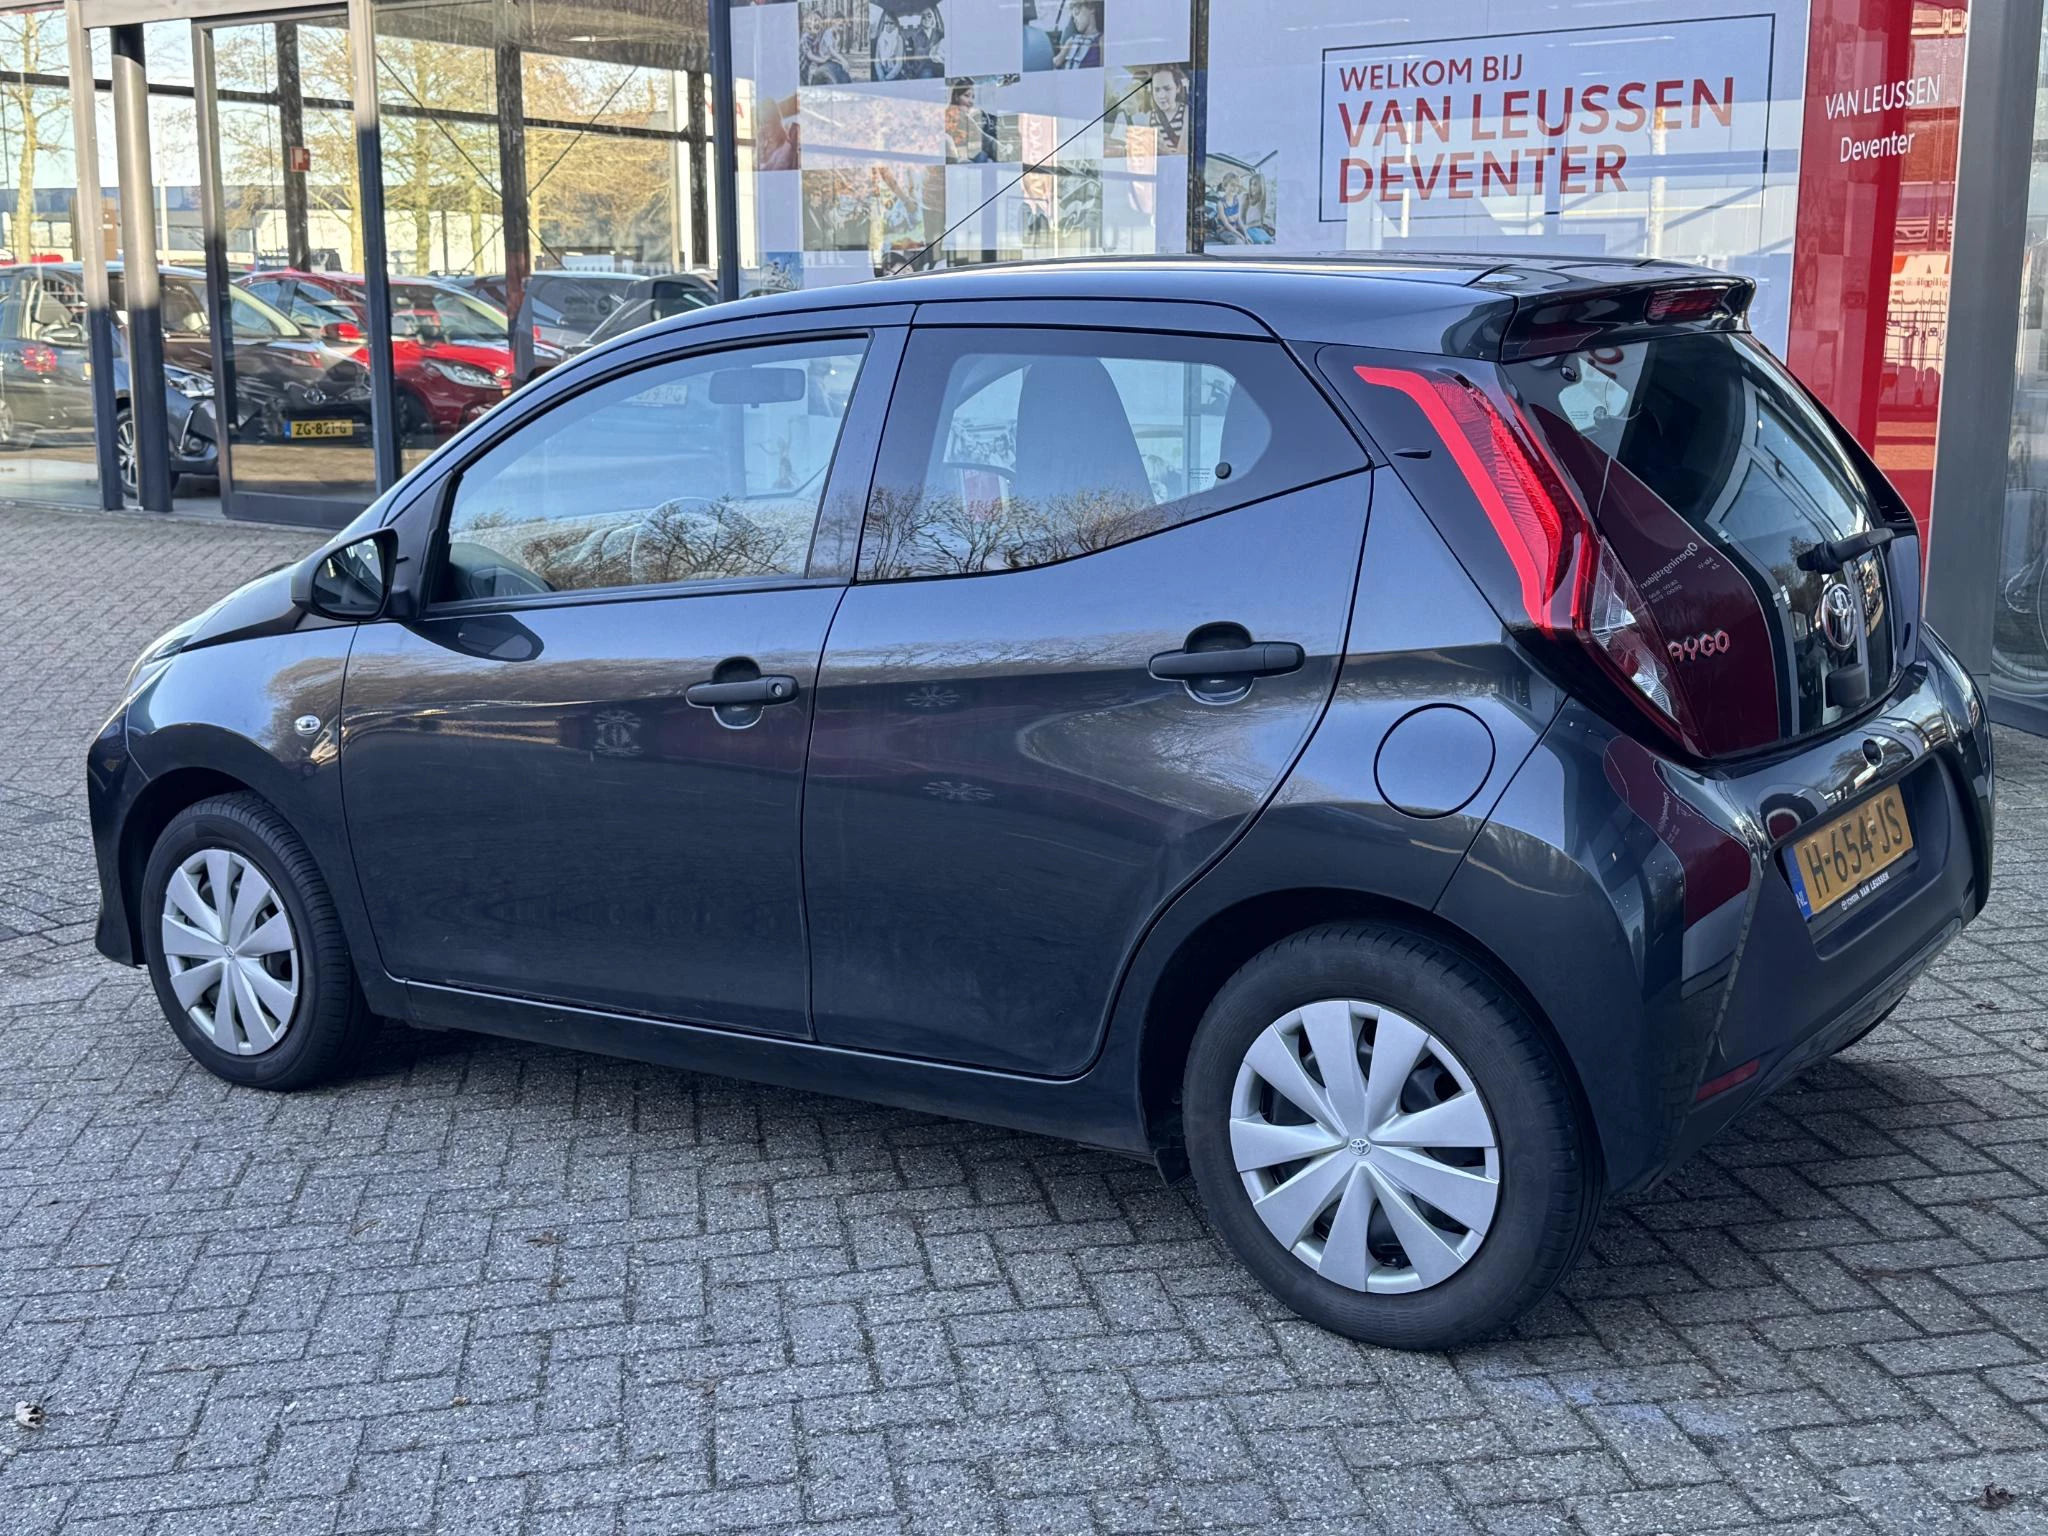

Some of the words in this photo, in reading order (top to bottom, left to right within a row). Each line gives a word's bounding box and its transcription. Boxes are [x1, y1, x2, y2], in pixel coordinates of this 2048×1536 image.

[1339, 57, 1472, 92] WELKOM
[1482, 53, 1524, 83] BIJ
[1337, 94, 1452, 148] VAN
[1471, 76, 1734, 141] LEUSSEN
[1825, 89, 1859, 120] VAN
[1863, 74, 1941, 114] LEUSSEN
[1840, 130, 1916, 162] Deventer
[1339, 144, 1629, 204] DEVENTER
[1667, 630, 1730, 661] AYGO
[1802, 795, 1903, 899] H-654-JS
[1795, 890, 1808, 909] NL
